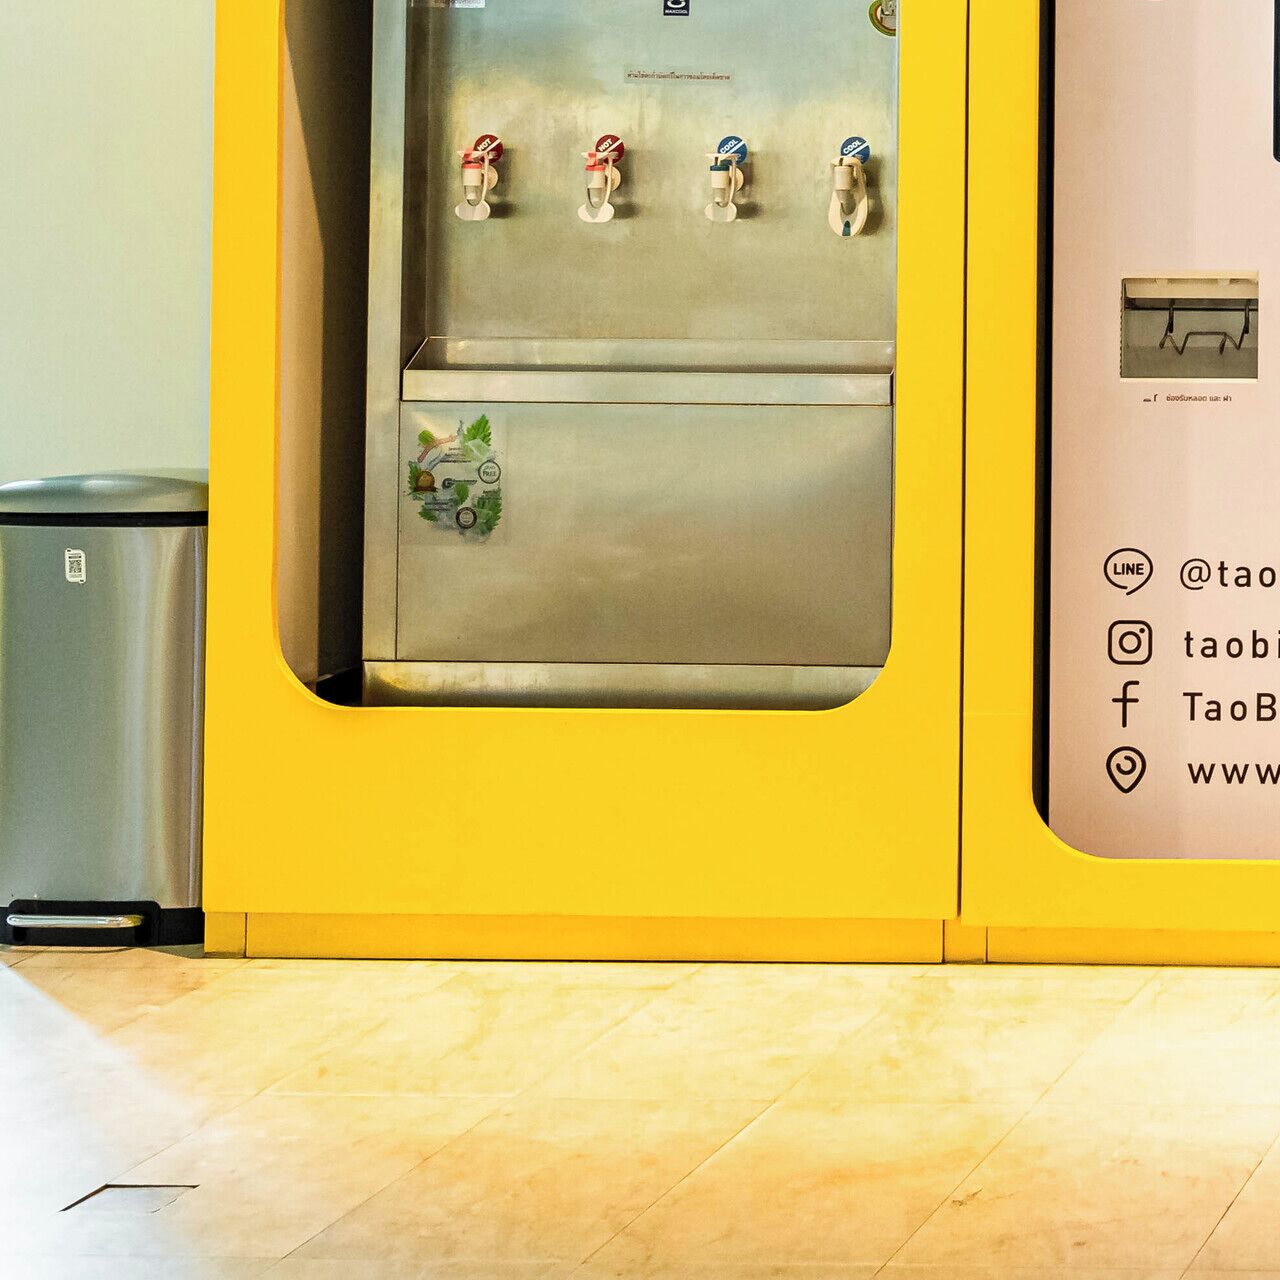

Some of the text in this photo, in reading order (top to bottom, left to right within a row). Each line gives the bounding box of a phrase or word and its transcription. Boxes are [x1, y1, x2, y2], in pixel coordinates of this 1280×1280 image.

[477, 138, 492, 152] HOT
[598, 138, 613, 152] HOT
[720, 139, 738, 154] COOL
[843, 139, 861, 154] COOL
[1113, 563, 1145, 576] LINE
